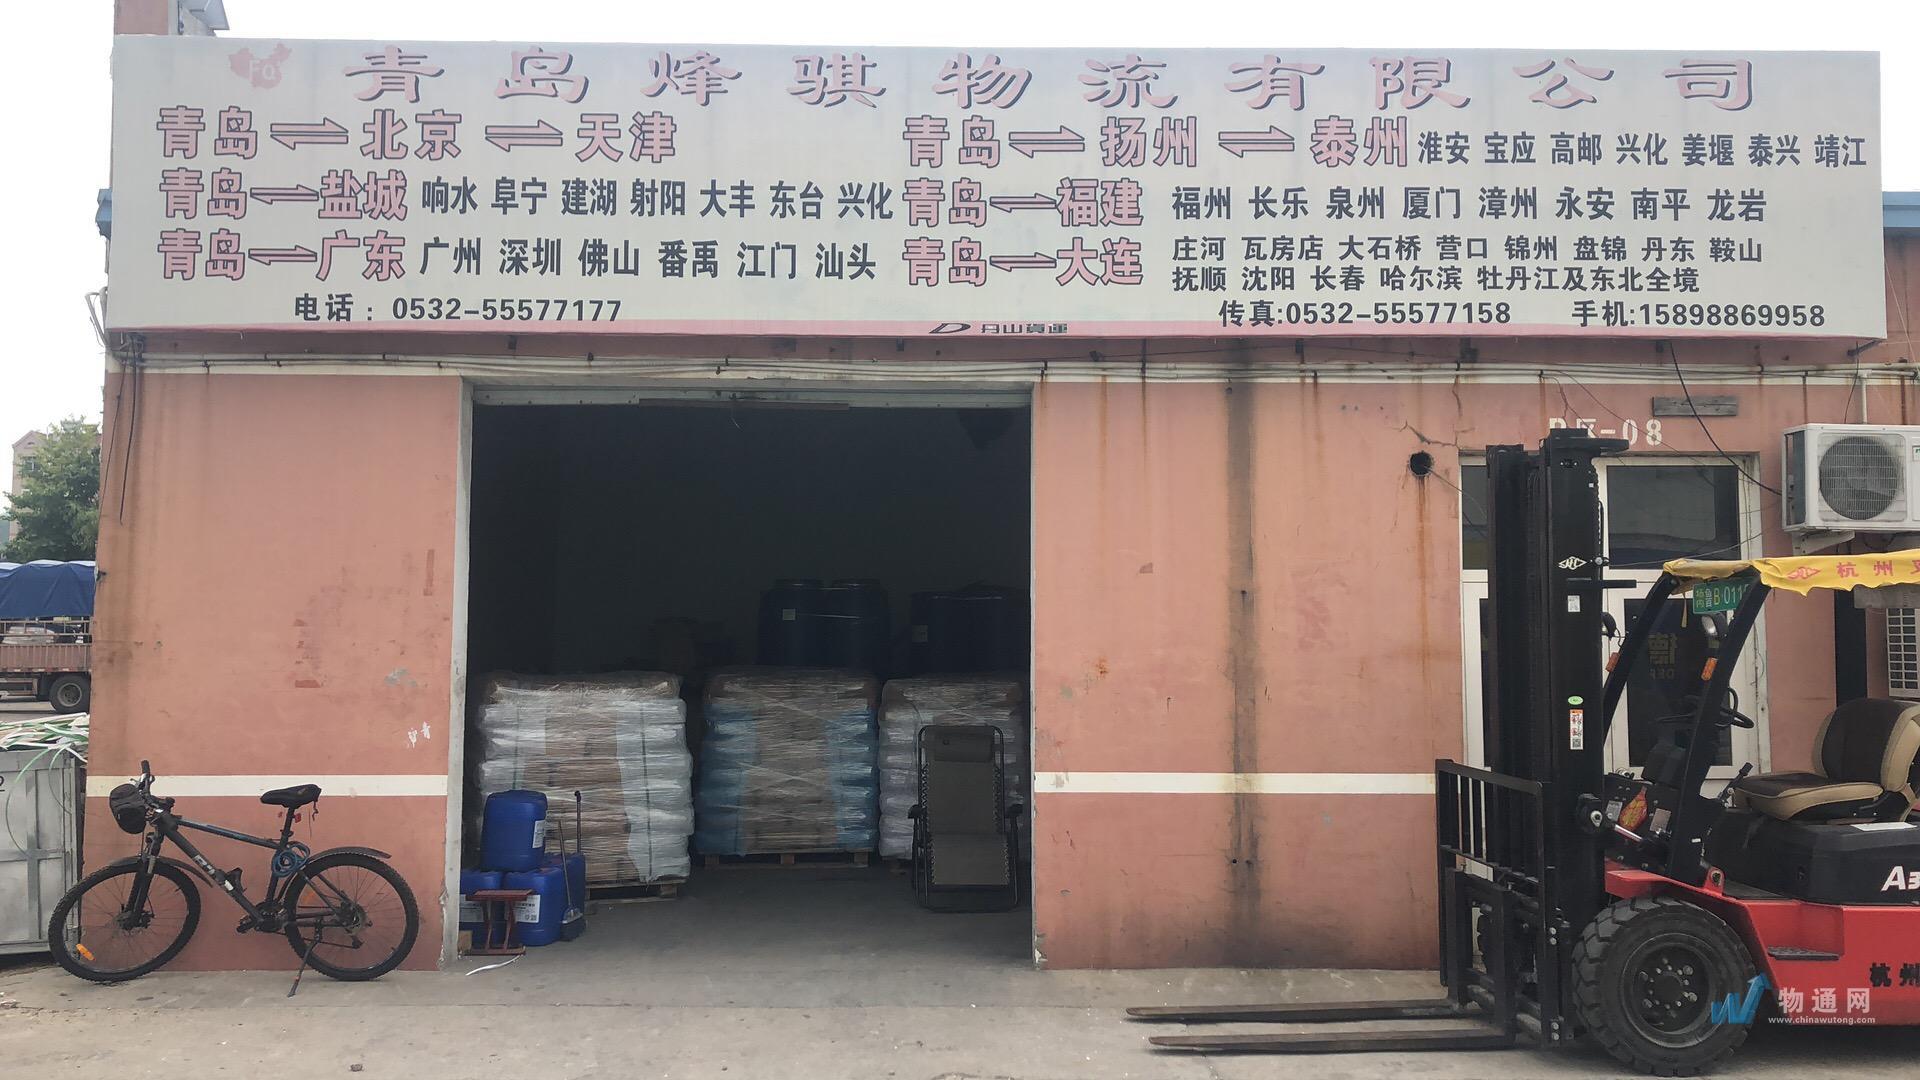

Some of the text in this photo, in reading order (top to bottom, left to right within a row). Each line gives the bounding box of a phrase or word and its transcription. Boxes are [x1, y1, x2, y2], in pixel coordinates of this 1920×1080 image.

[345, 46, 1754, 110] 青岛烽骐物流有限公司
[156, 105, 677, 163] 青岛 北京 天津
[903, 115, 1866, 168] 青岛 扬州 泰州 淮安 宝应 高邮 兴化 姜堰 泰兴 靖江
[158, 167, 893, 221] 青岛 盐城 响水 阜宁 建湖 射阳 大丰 东台 兴化
[903, 177, 1766, 228] 青岛 福建 福州 长乐 泉州 厦门 漳州 永安 南平 龙岩
[157, 228, 247, 281] 青岛
[315, 229, 405, 281] 广东
[420, 237, 481, 275] 广州
[499, 238, 561, 275] 深圳
[578, 239, 639, 277] 佛山
[737, 242, 796, 279] 江门
[816, 243, 876, 280] 汕头
[903, 236, 1143, 287] 青岛 大连
[1173, 235, 1761, 262] 庄河 瓦房店 大石桥 营口 锦州 盘锦 丹东 鞍山
[1172, 265, 1699, 292] 抚顺 沈阳 长春 哈尔滨 牡丹江及东北全境
[393, 298, 621, 322] 0532-55577177
[1219, 300, 1510, 327] 传真:0532-55577158
[1572, 300, 1824, 327] 手机:15898869958
